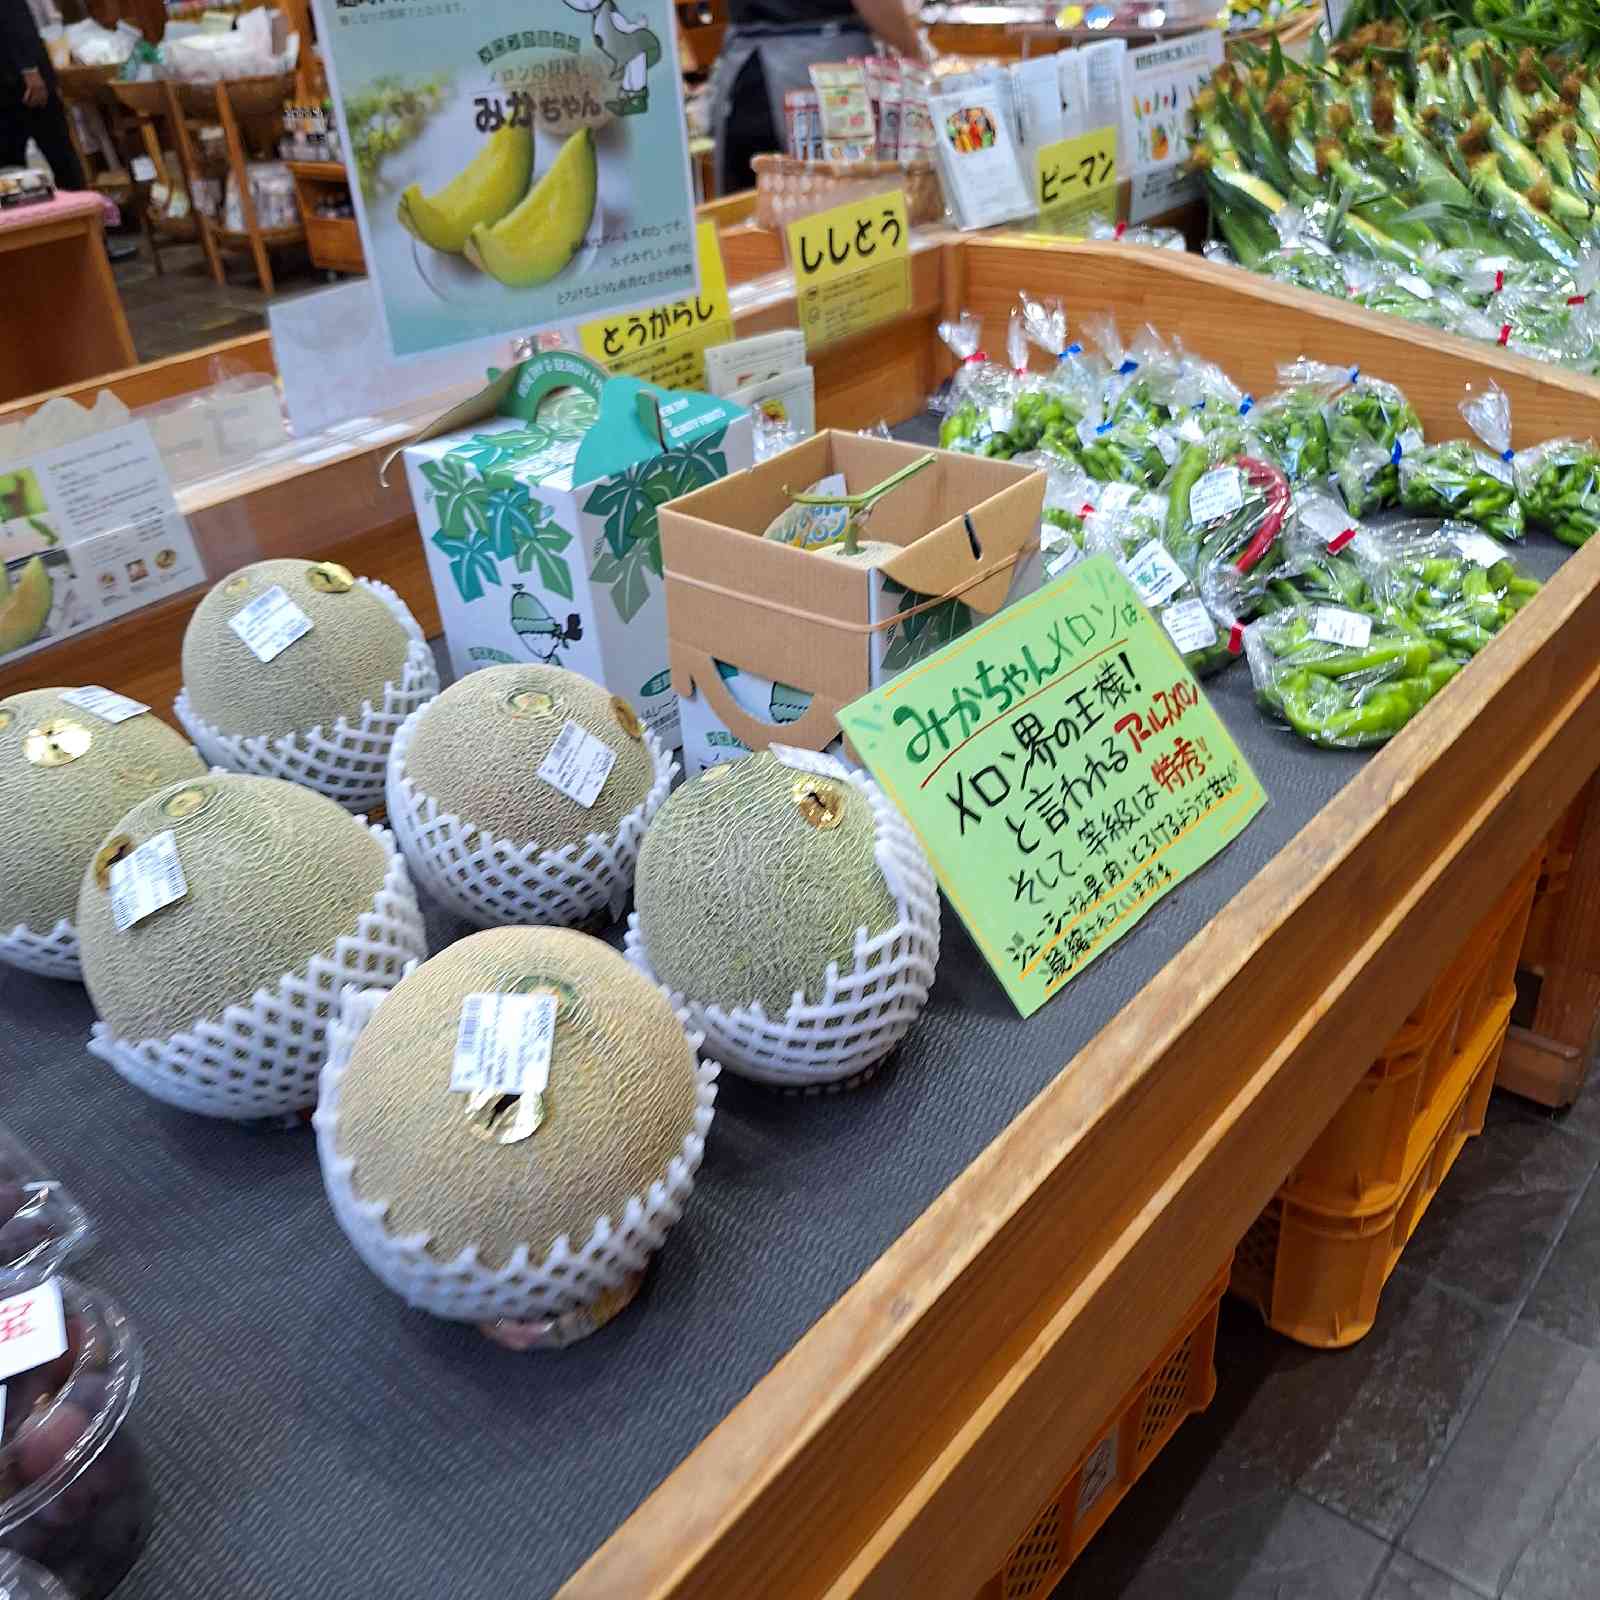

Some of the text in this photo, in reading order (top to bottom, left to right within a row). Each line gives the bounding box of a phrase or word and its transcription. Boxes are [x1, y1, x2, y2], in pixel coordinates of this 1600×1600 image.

[473, 90, 602, 133] みかちゃん
[799, 209, 902, 273] ししとう
